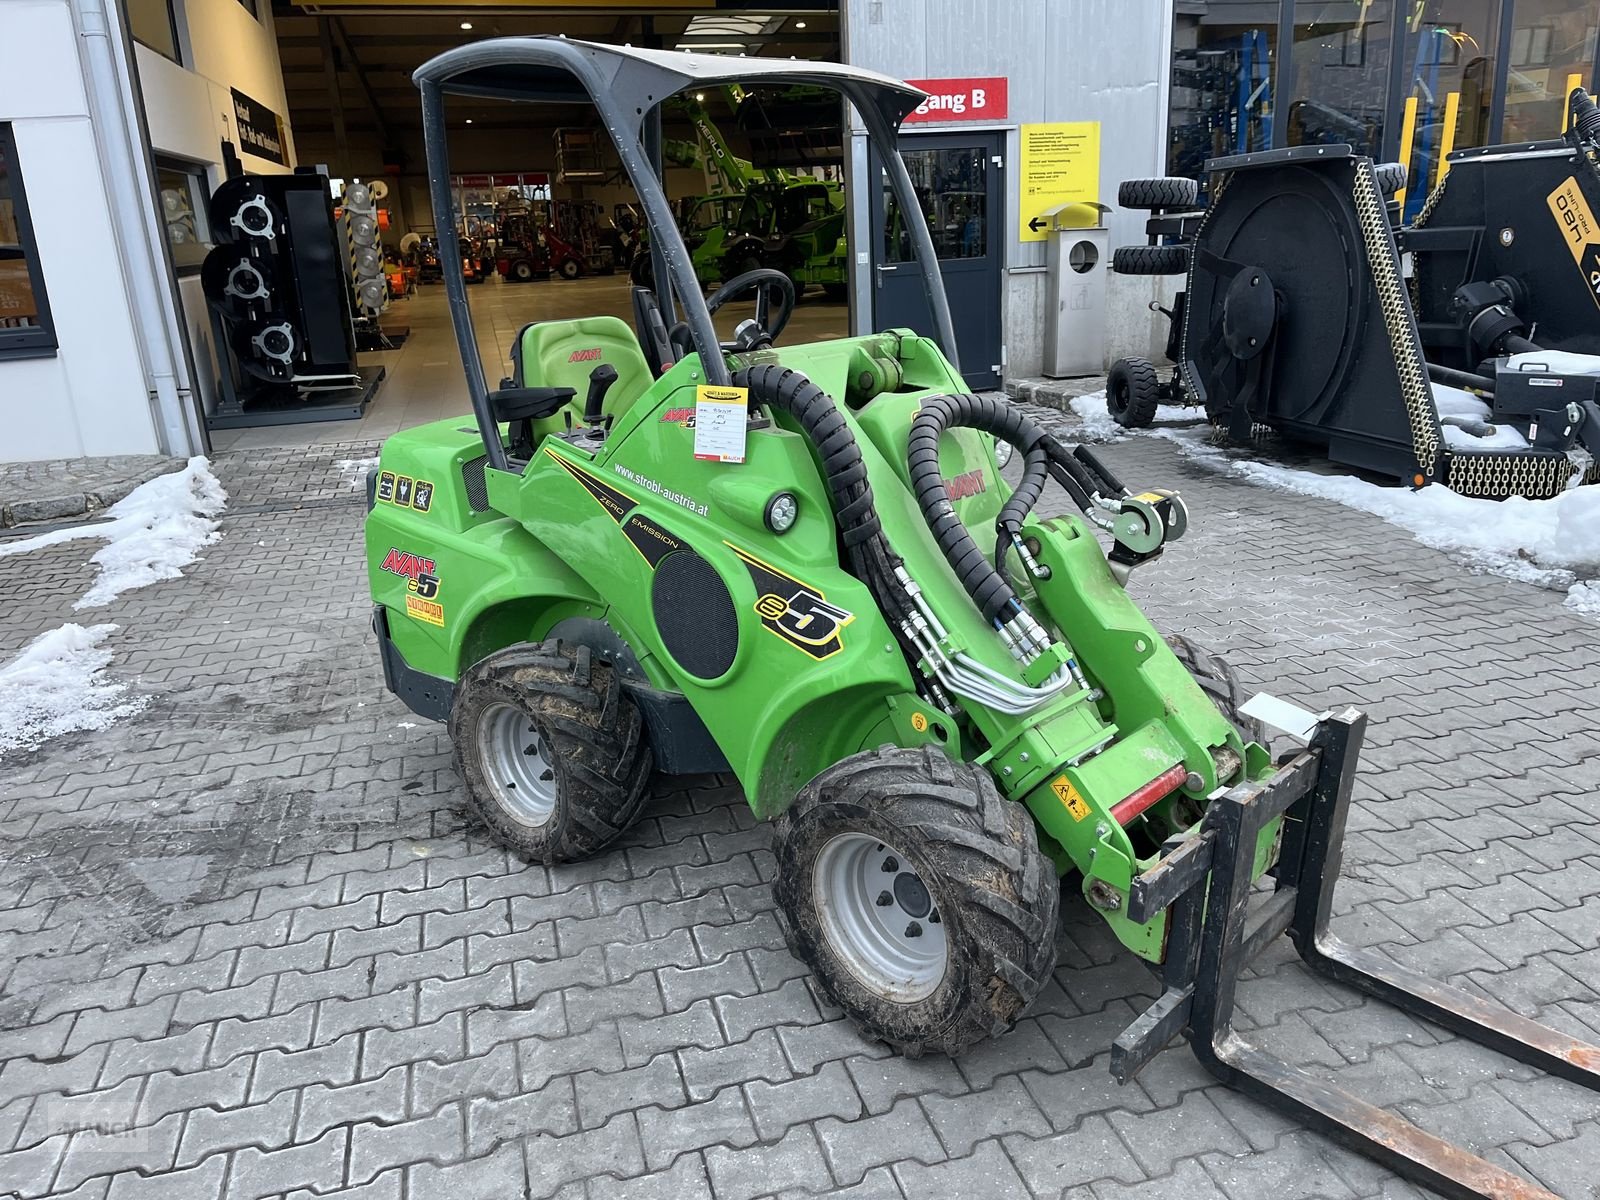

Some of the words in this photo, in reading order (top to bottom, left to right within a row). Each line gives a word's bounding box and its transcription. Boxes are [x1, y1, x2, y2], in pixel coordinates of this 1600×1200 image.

[972, 89, 986, 108] B
[697, 119, 725, 158] MERLO
[1556, 195, 1582, 242] 480
[1566, 188, 1590, 234] PRO-LINE
[568, 348, 602, 363] AVANT
[659, 407, 696, 423] AVAN
[614, 463, 709, 517] www.strobl-austria.at
[600, 496, 624, 515] ZERO
[631, 518, 679, 549] EMISSION
[380, 547, 437, 580] AVANT
[407, 573, 441, 601] e5
[754, 590, 856, 646] e5
